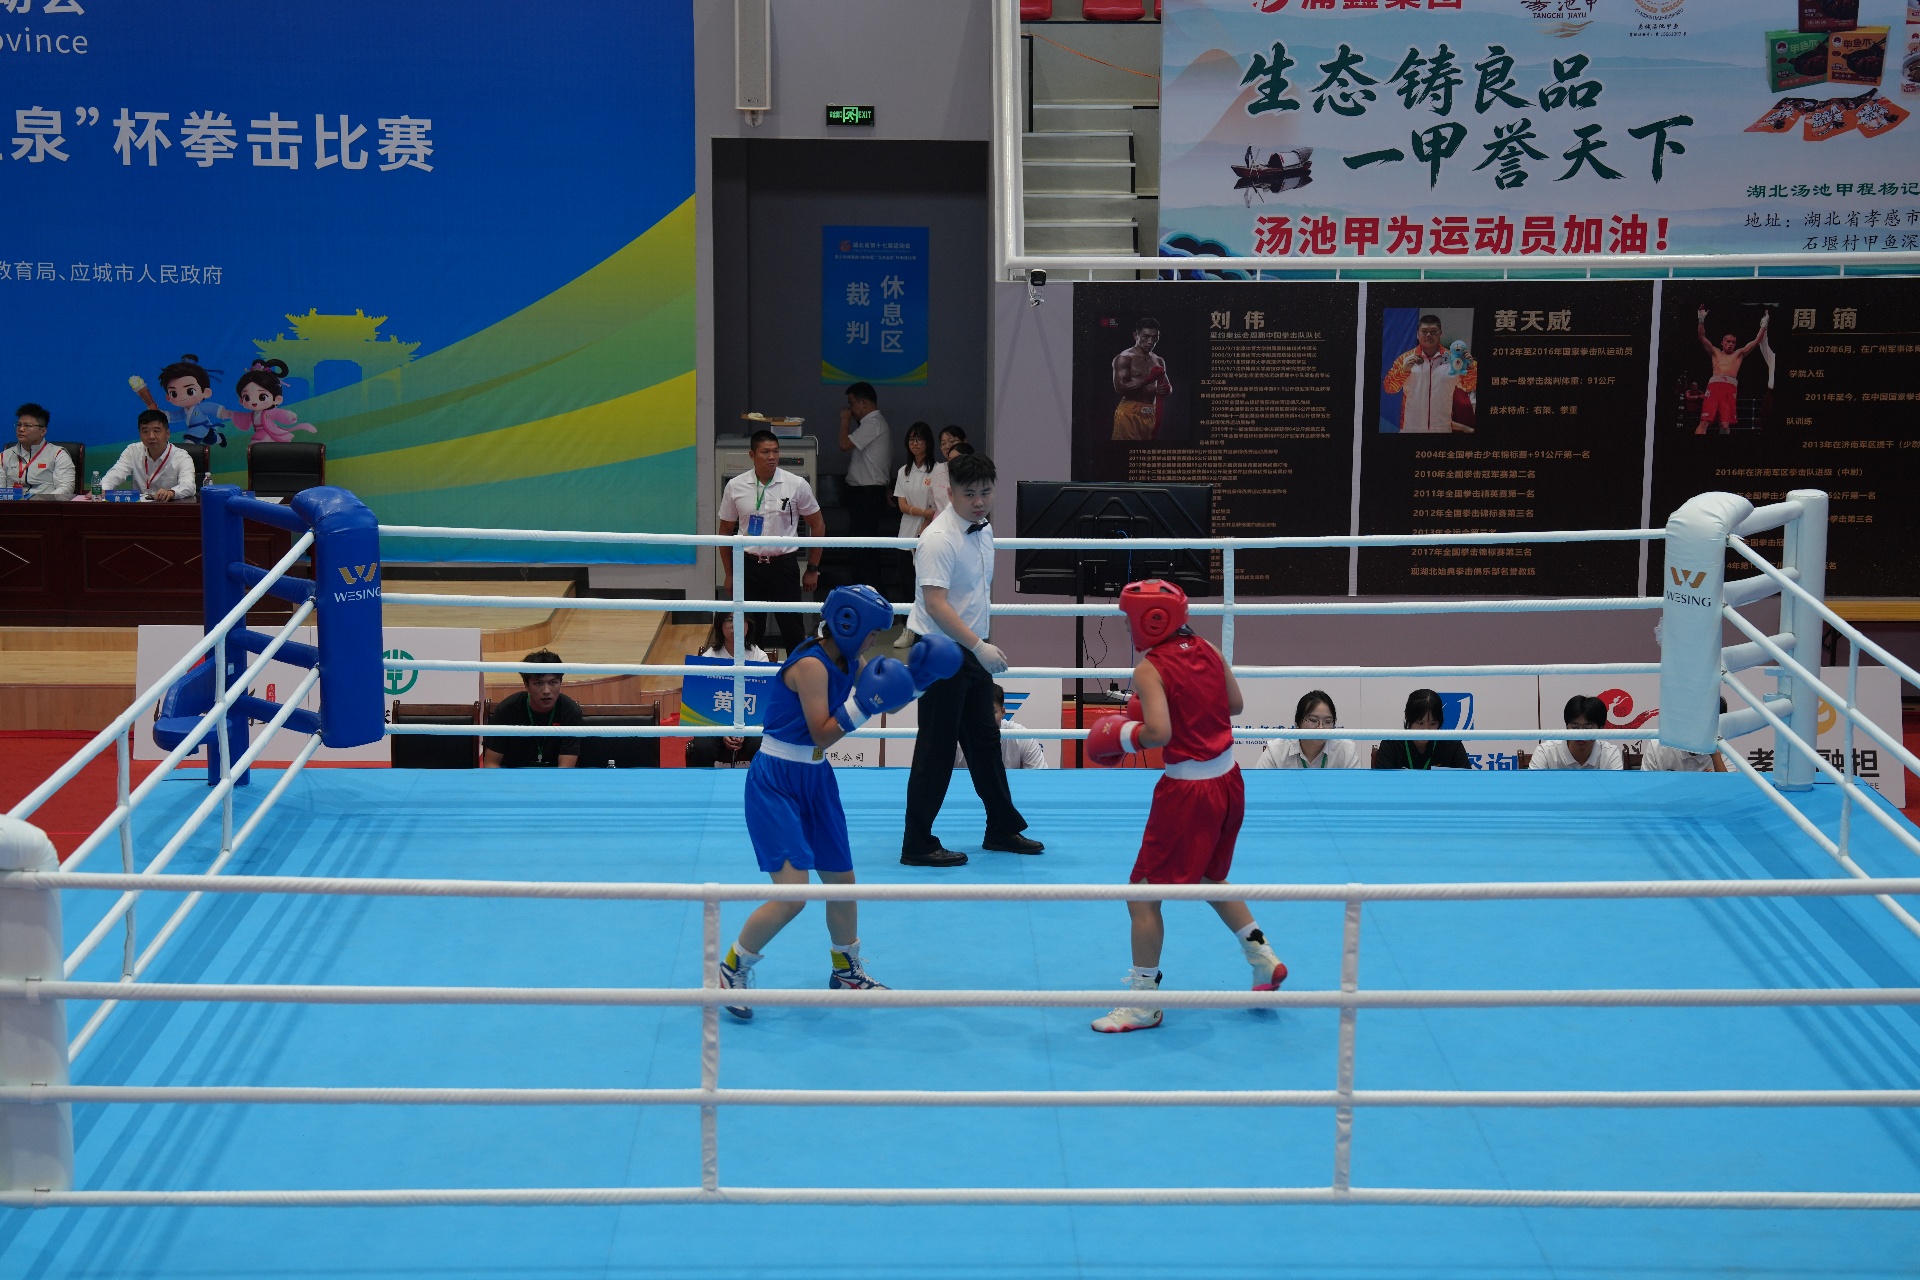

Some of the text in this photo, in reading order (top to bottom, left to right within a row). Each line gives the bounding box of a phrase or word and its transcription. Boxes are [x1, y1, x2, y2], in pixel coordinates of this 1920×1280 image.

[0, 27, 88, 55] vince
[1239, 41, 1604, 117] 生态铸良品
[858, 110, 872, 119] EXIT
[0, 104, 435, 173] 泉”杯拳击比赛
[1342, 115, 1696, 192] 一甲誉天下
[1746, 182, 1920, 199] 湖北汤池甲程杨记
[1254, 213, 1671, 256] 汤池甲为运动员加油！
[0, 260, 223, 286] 教育局、应城市人民政府
[846, 281, 871, 345] 裁判
[880, 274, 905, 353] 休息区
[1210, 310, 1265, 330] 刘伟
[1494, 310, 1572, 332] 黄天威
[1492, 347, 1633, 357] 2012年至2016年国家拳击队运动员
[1789, 369, 1825, 378] 学院入伍
[1786, 416, 1813, 426] 队训练
[1666, 590, 1711, 607] WESING
[825, 752, 864, 762] 限公司
